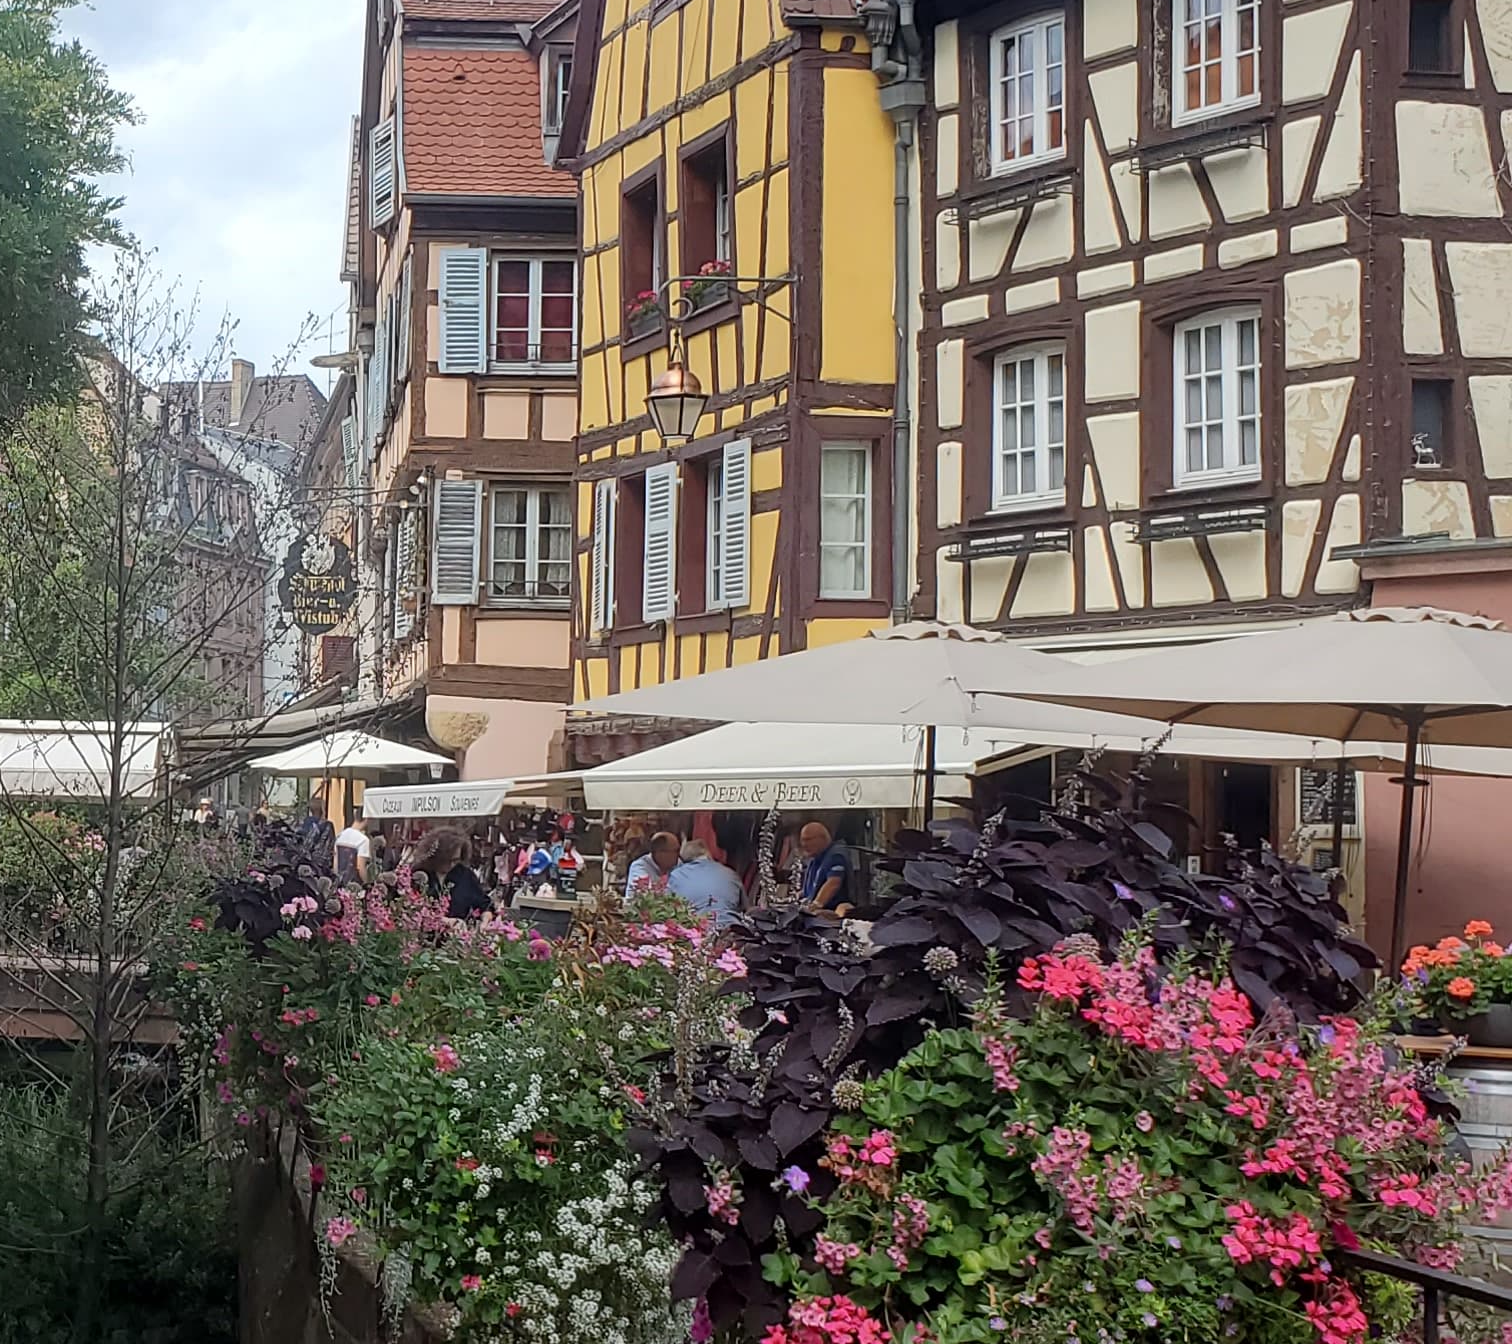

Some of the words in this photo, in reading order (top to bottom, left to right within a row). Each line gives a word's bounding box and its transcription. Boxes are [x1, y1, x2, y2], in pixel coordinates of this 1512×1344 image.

[700, 783, 748, 803] DEER
[750, 783, 768, 803] &
[773, 782, 822, 803] BEER
